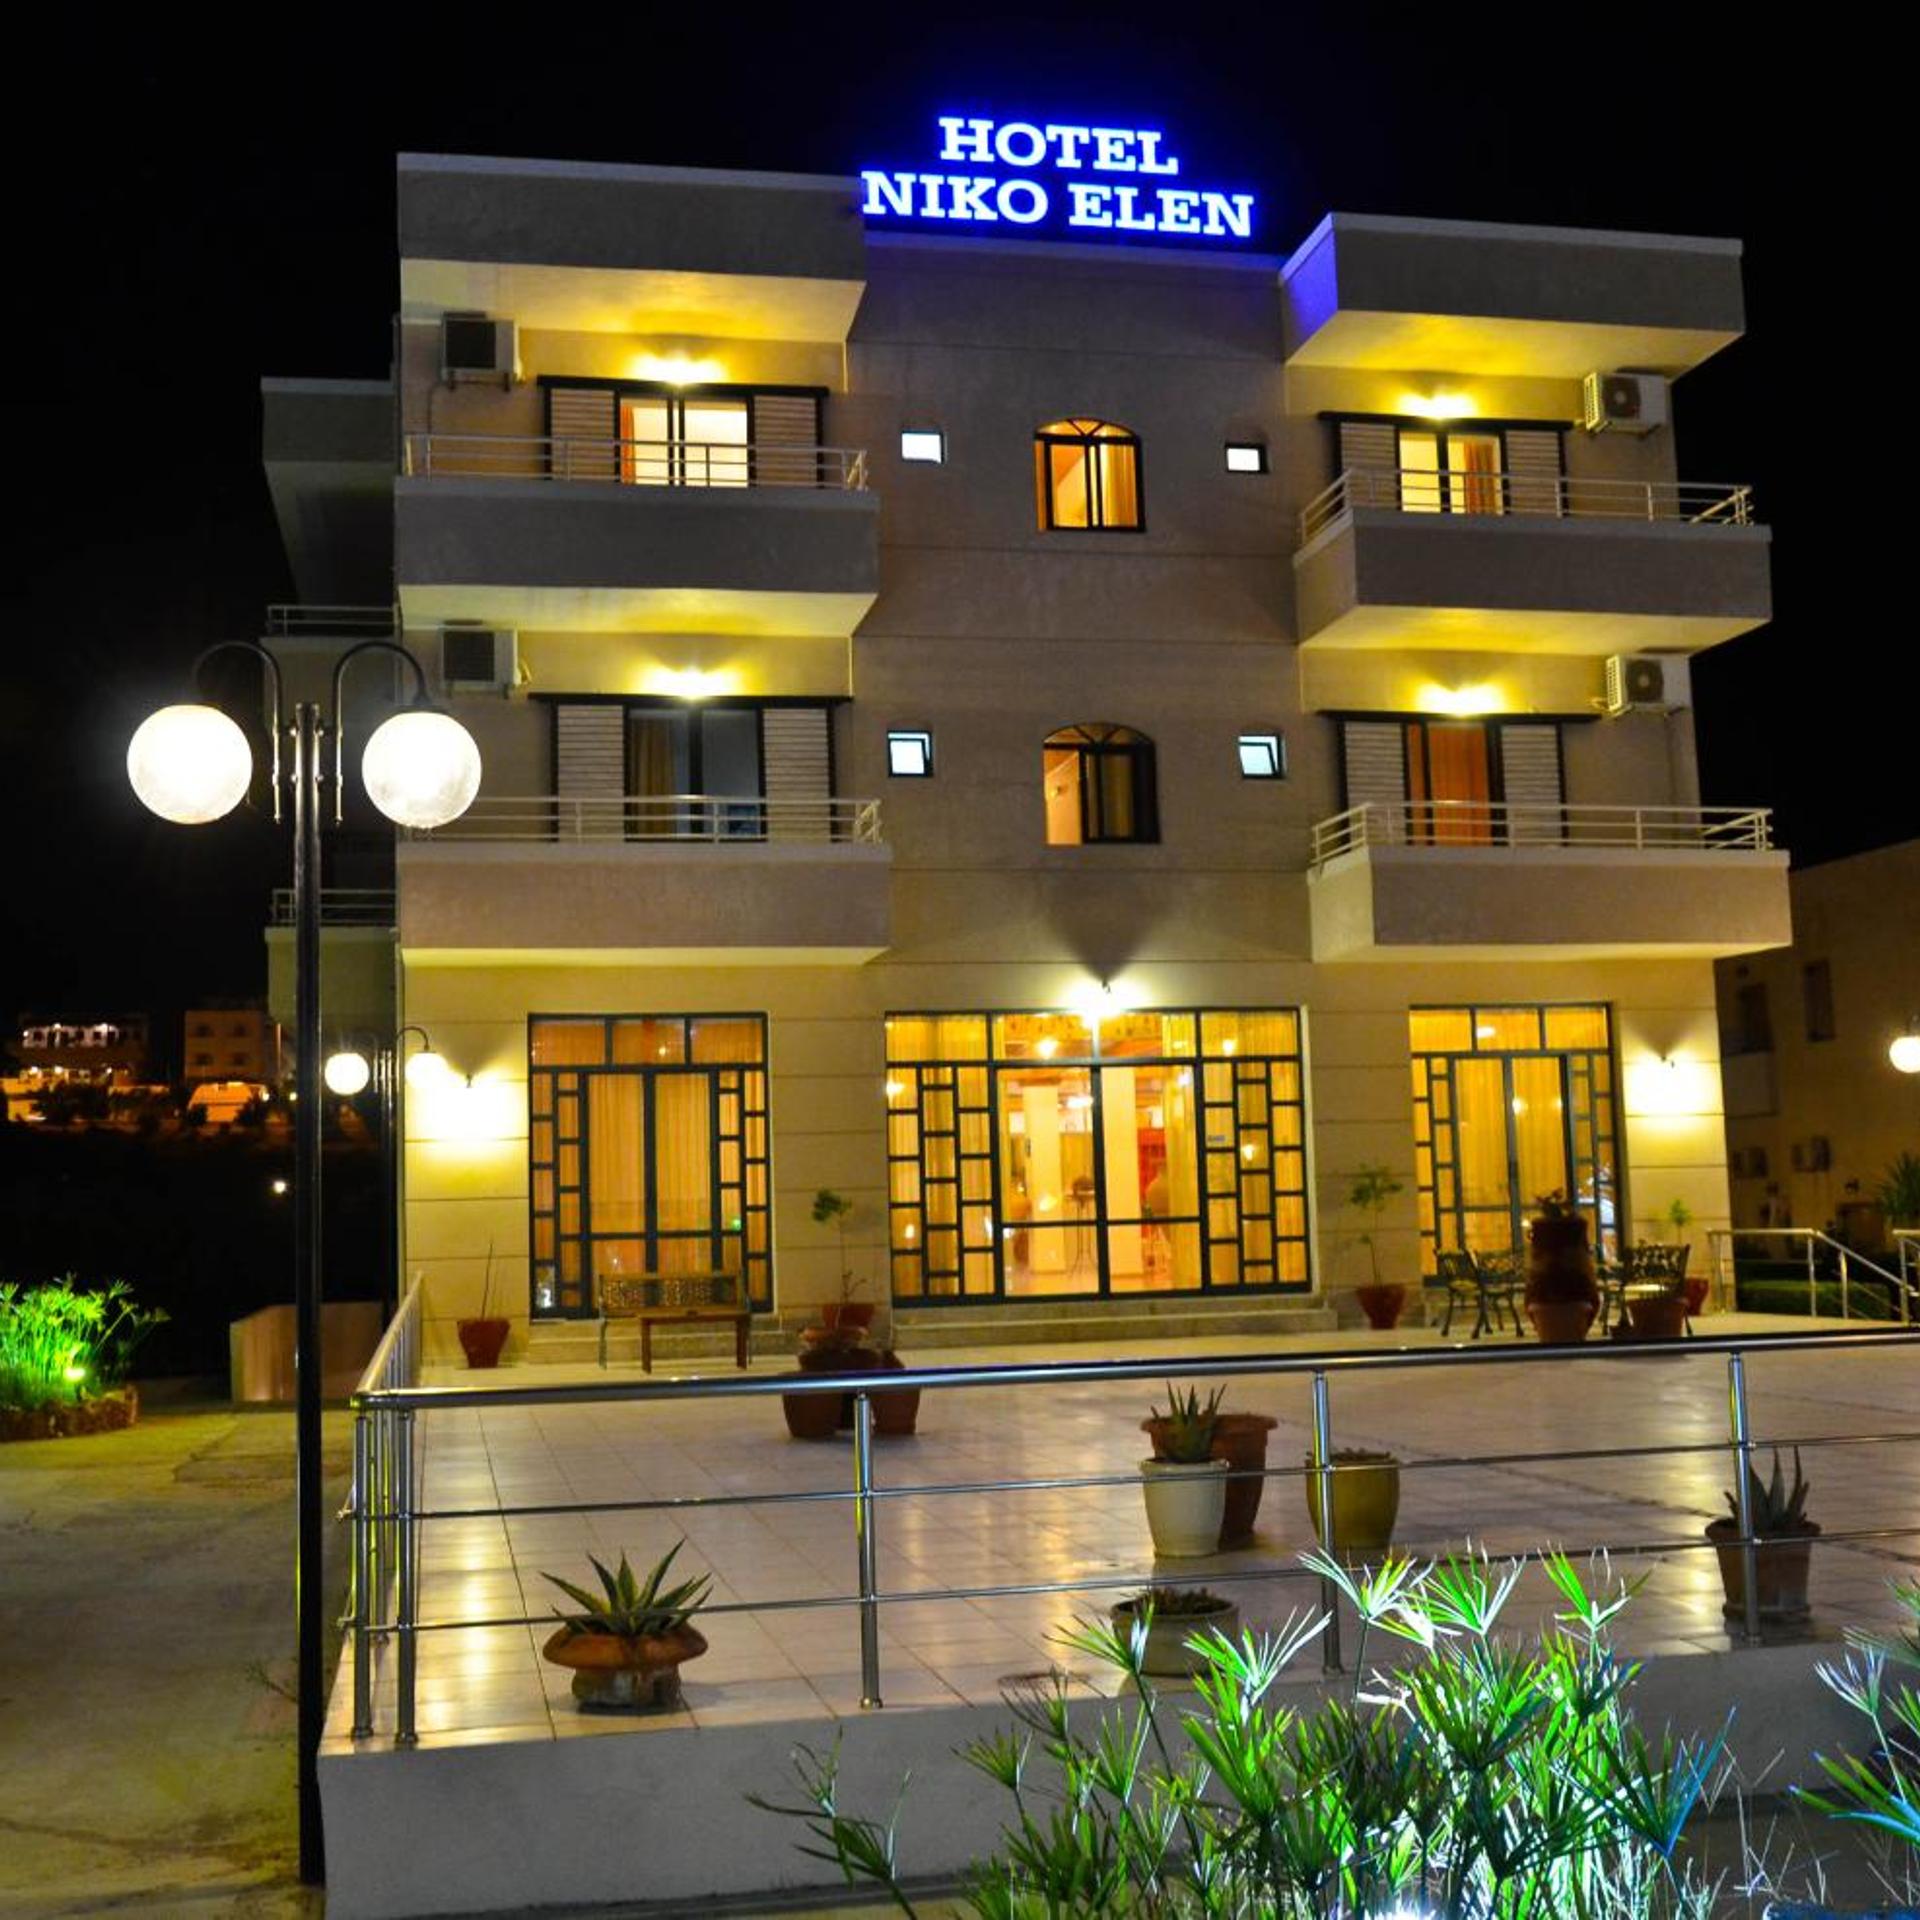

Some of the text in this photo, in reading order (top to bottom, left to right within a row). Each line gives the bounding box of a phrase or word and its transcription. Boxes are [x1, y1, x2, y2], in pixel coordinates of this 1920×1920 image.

[938, 117, 1180, 175] HOTEL
[861, 170, 1254, 237] NIKO ELEN
